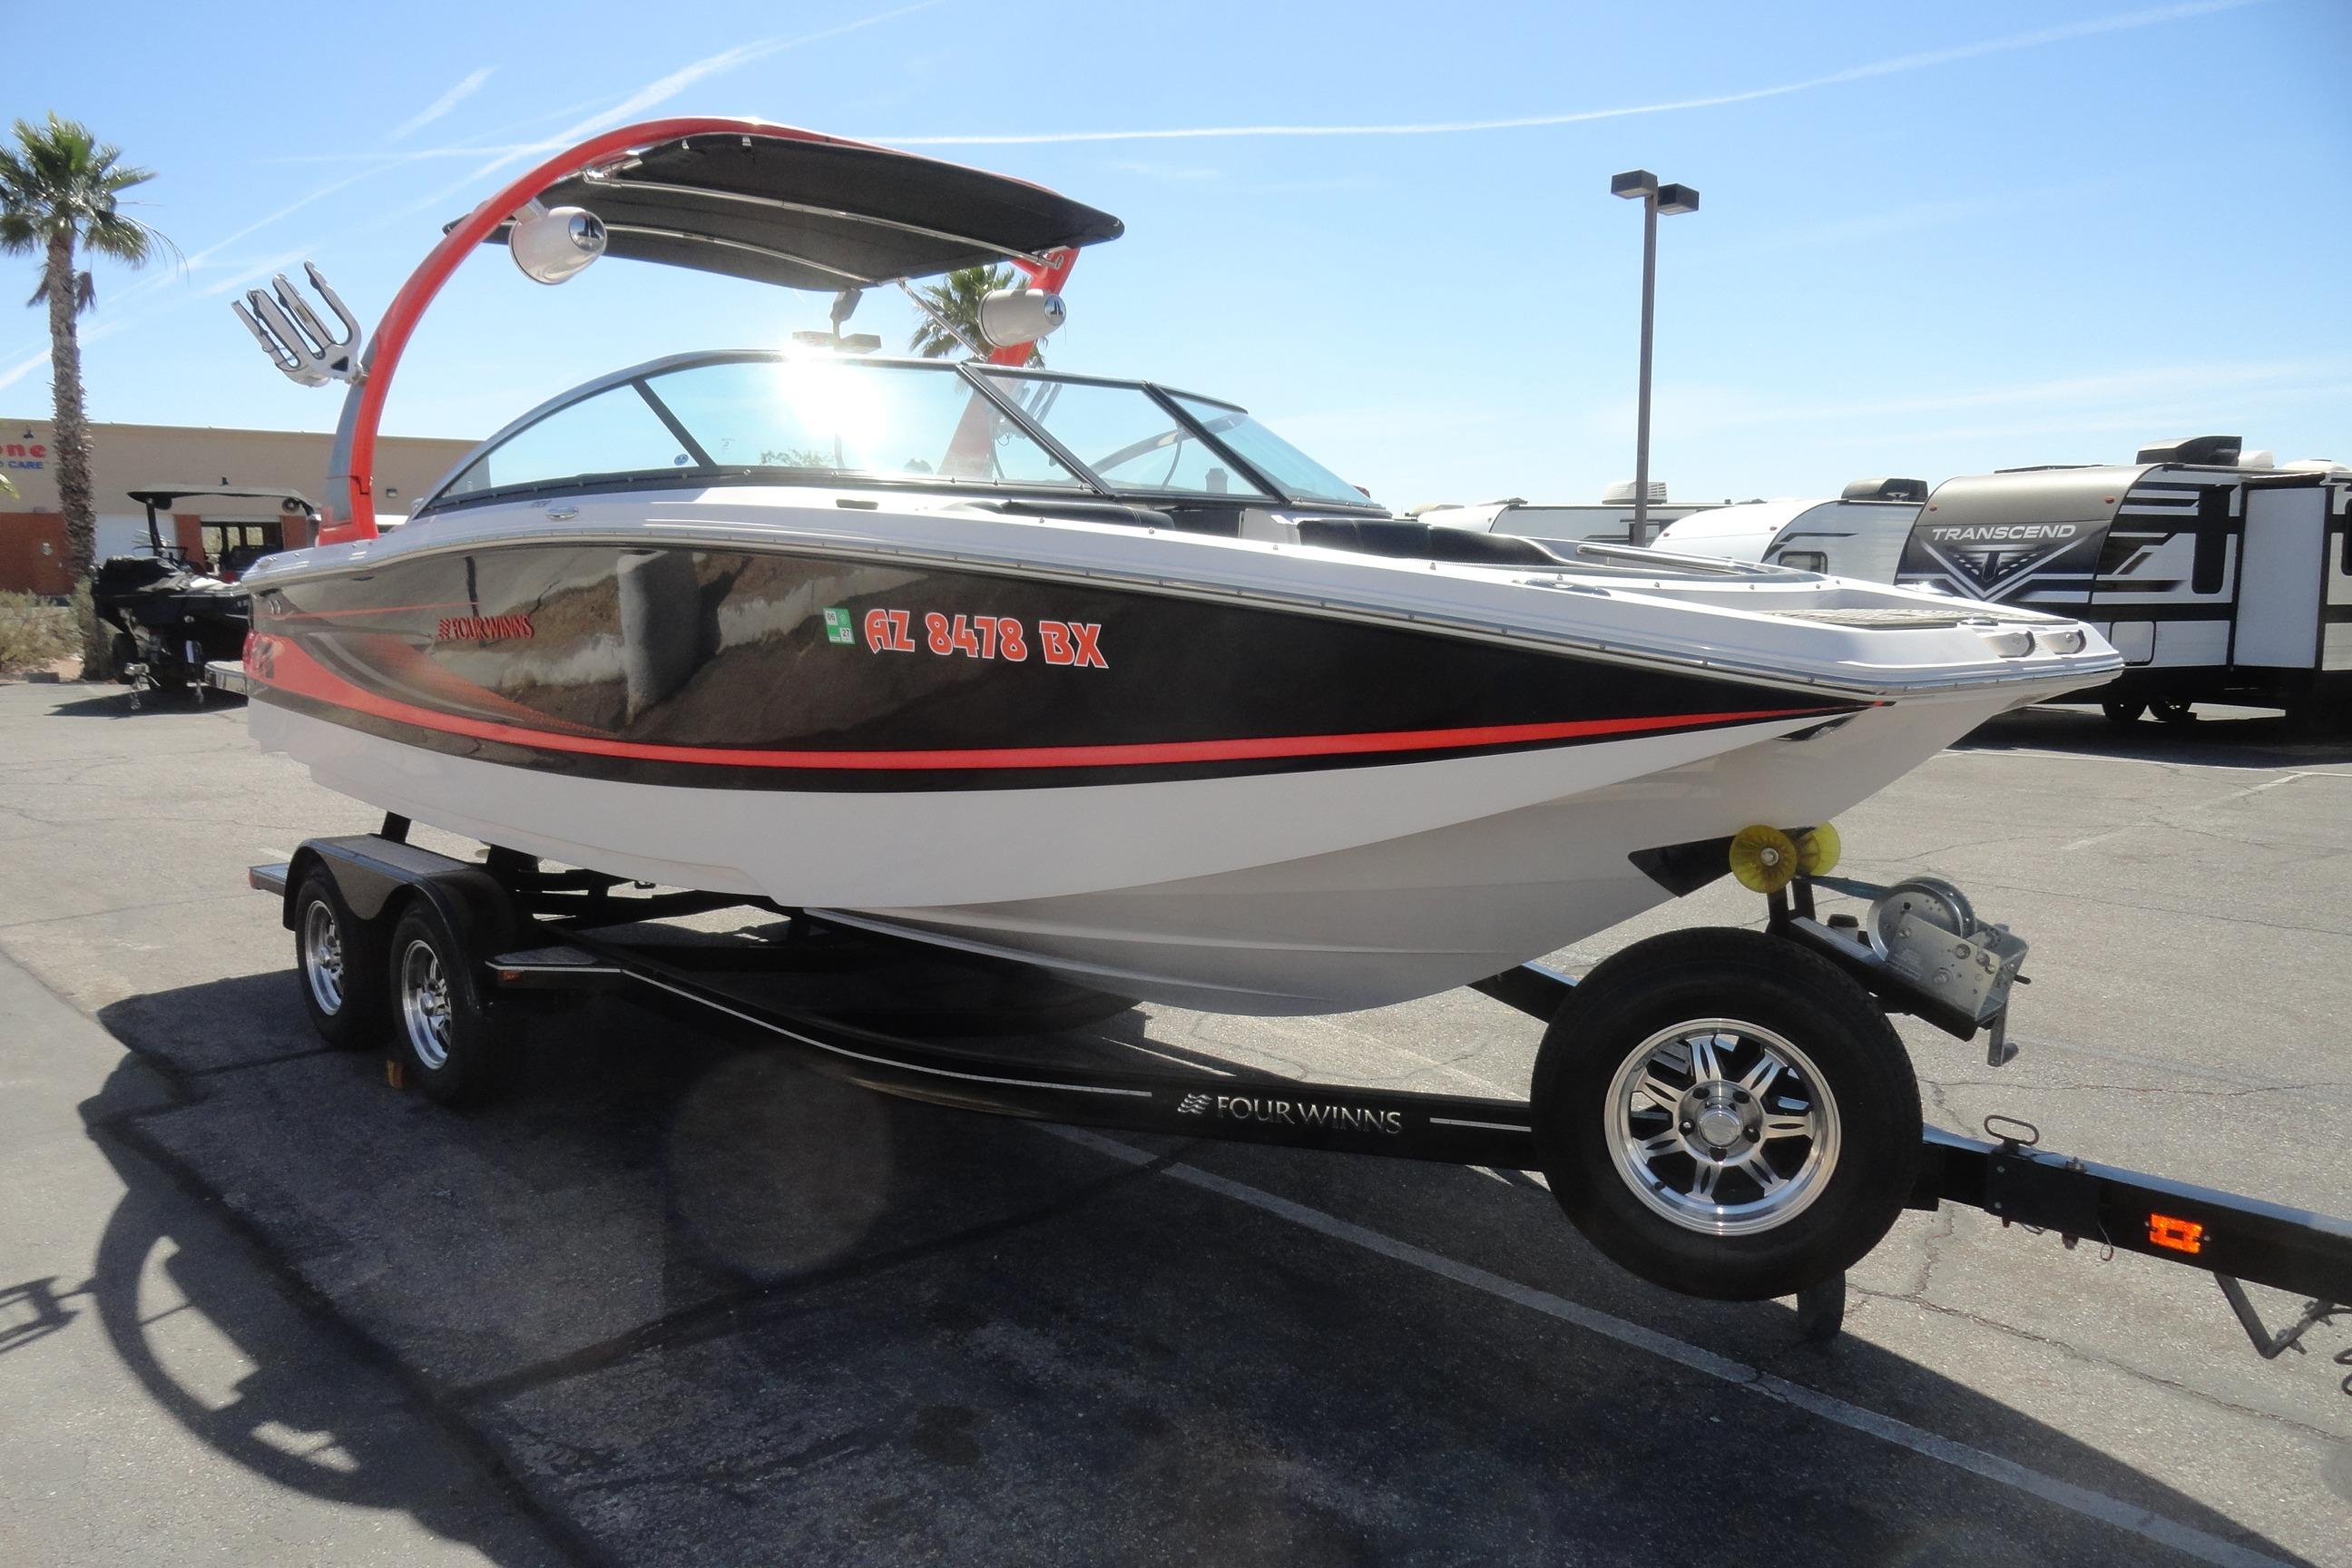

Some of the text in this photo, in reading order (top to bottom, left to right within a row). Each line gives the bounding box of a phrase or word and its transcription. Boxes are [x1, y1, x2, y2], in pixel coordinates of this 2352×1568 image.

[0, 444, 46, 458] ne
[1932, 524, 2077, 541] TRANSCEND
[450, 614, 535, 640] FOUR WINNS
[865, 609, 1109, 669] AZ 8478 BX
[1218, 1096, 1402, 1133] FOUR WINNS
